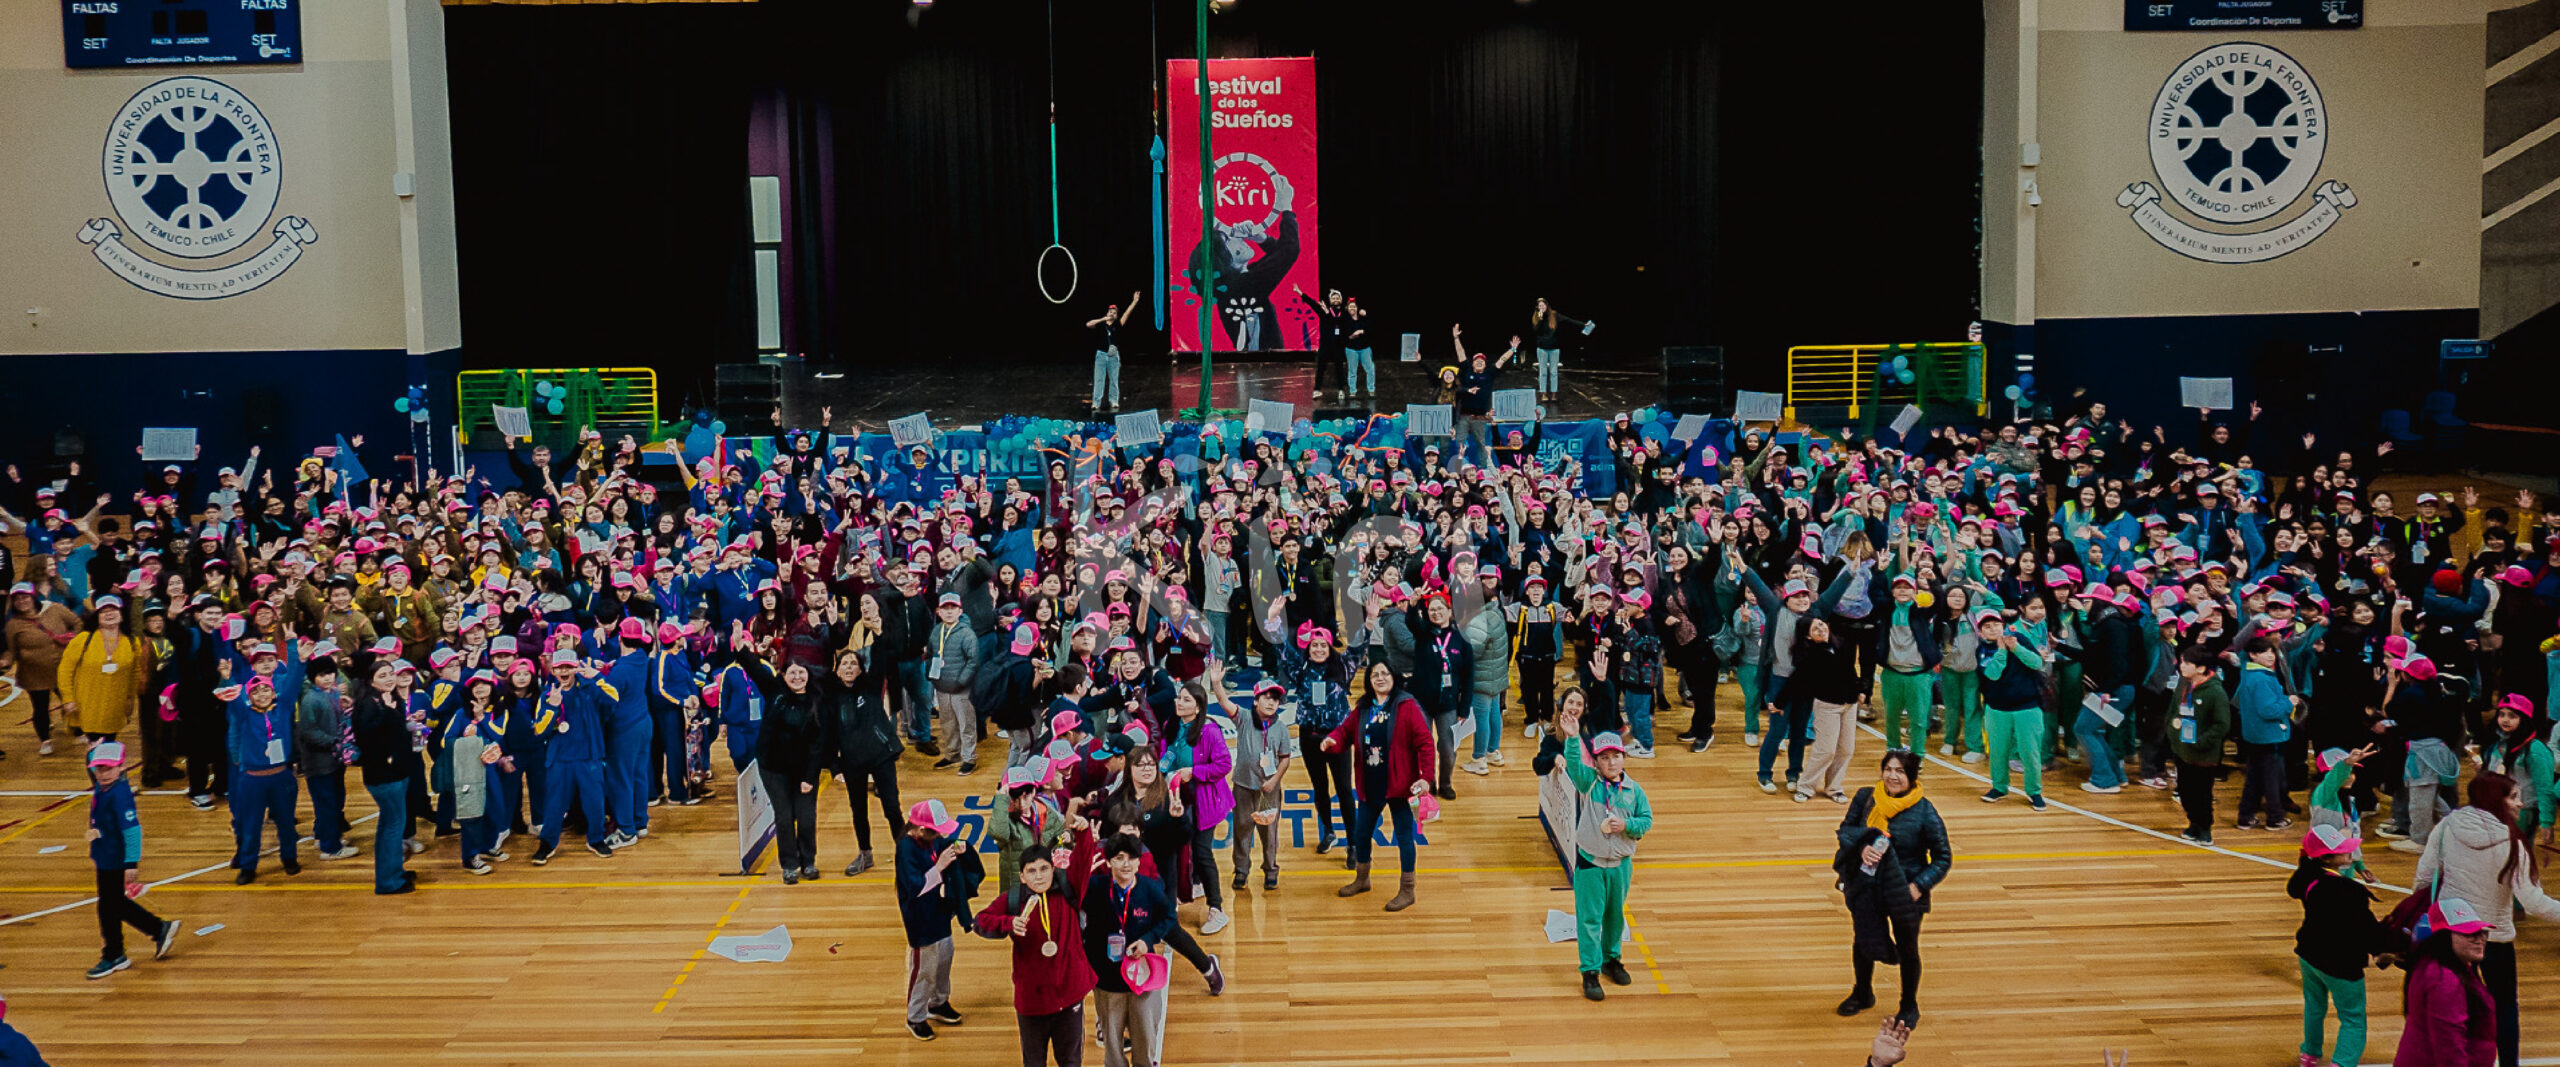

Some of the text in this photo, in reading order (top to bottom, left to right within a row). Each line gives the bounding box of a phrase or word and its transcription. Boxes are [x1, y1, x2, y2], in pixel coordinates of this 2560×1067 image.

[72, 2, 118, 14] FALTAS
[241, 0, 287, 10] FALTAS
[2148, 4, 2173, 17] SET
[2321, 1, 2346, 12] SET
[2249, 17, 2260, 25] De
[2263, 17, 2302, 26] Deportes
[83, 37, 109, 49] SET
[151, 37, 172, 45] FALTA
[252, 34, 277, 46] SET
[2159, 52, 2318, 140] UNIVERSIDAD DE LA FRONTERA
[1217, 97, 1258, 108] de los
[1211, 110, 1293, 128] Sueños
[113, 87, 272, 176] UNIVERSIDAD DE LA FRONTERA
[2185, 187, 2231, 214] TEMUCO
[2242, 195, 2276, 213] CHILE
[144, 220, 192, 247] TEMUCO
[201, 228, 236, 246] CHILE
[2211, 246, 2253, 255] MENTIS
[2257, 243, 2272, 252] AD
[176, 282, 218, 291] MENTIS
[221, 278, 235, 290] AD
